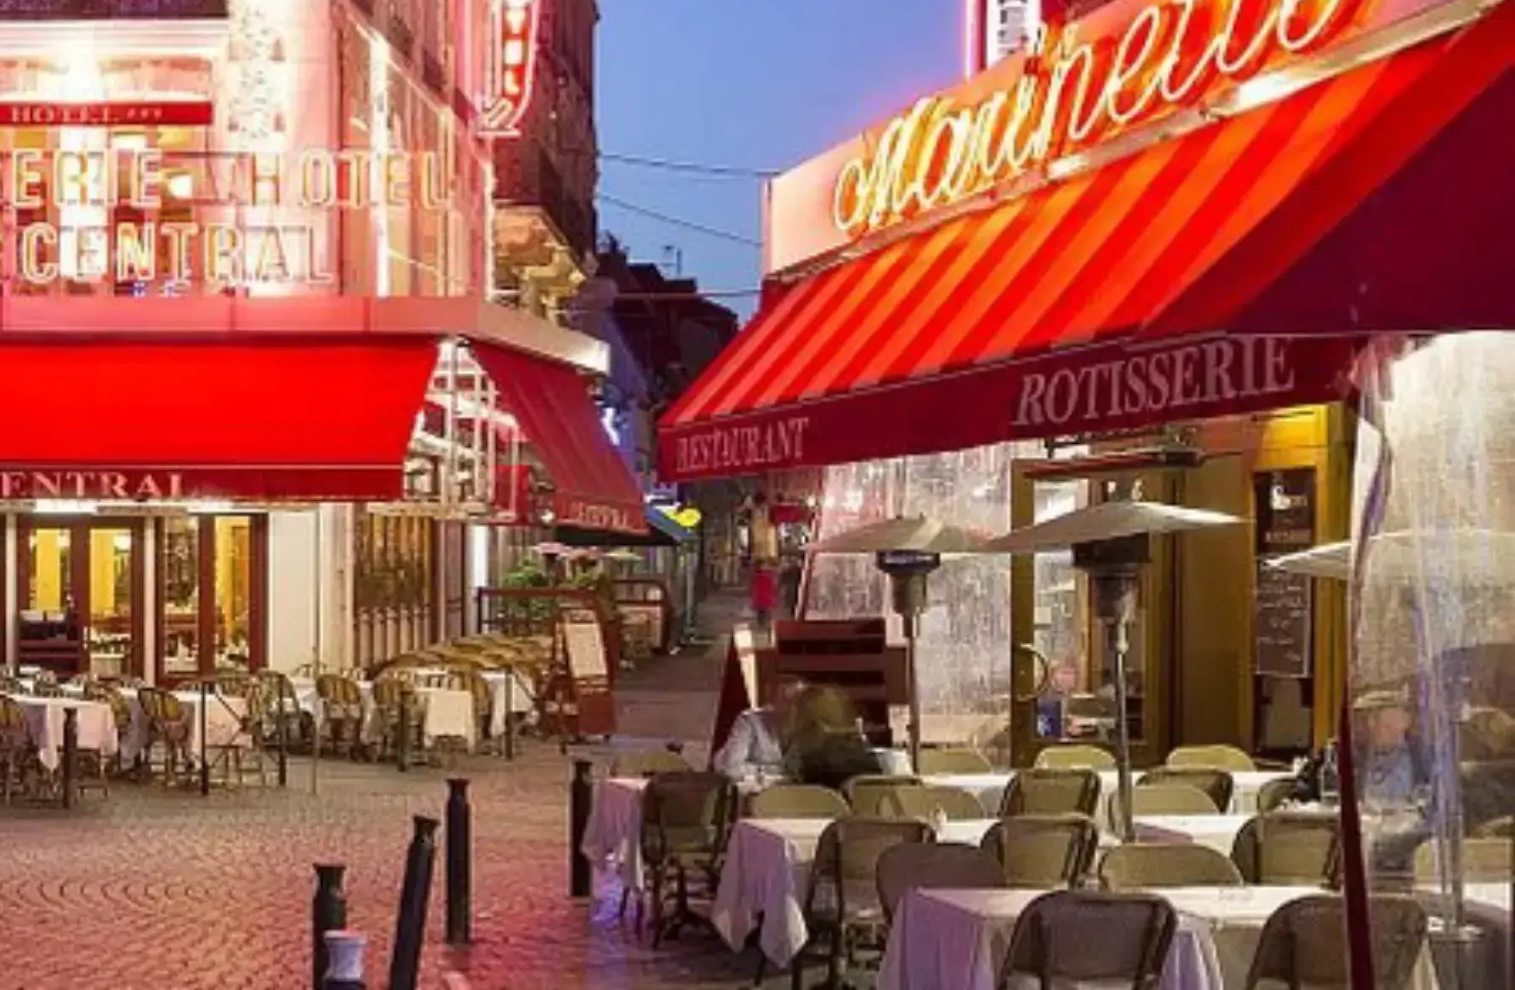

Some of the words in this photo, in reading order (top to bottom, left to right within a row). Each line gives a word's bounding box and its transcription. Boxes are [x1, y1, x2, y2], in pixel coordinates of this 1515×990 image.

[10, 105, 119, 123] HOTEL
[249, 148, 454, 210] HOTEL
[21, 220, 332, 284] CENTRAL
[1012, 335, 1295, 426] ROTISSERIE
[675, 416, 810, 473] RESTAURANT
